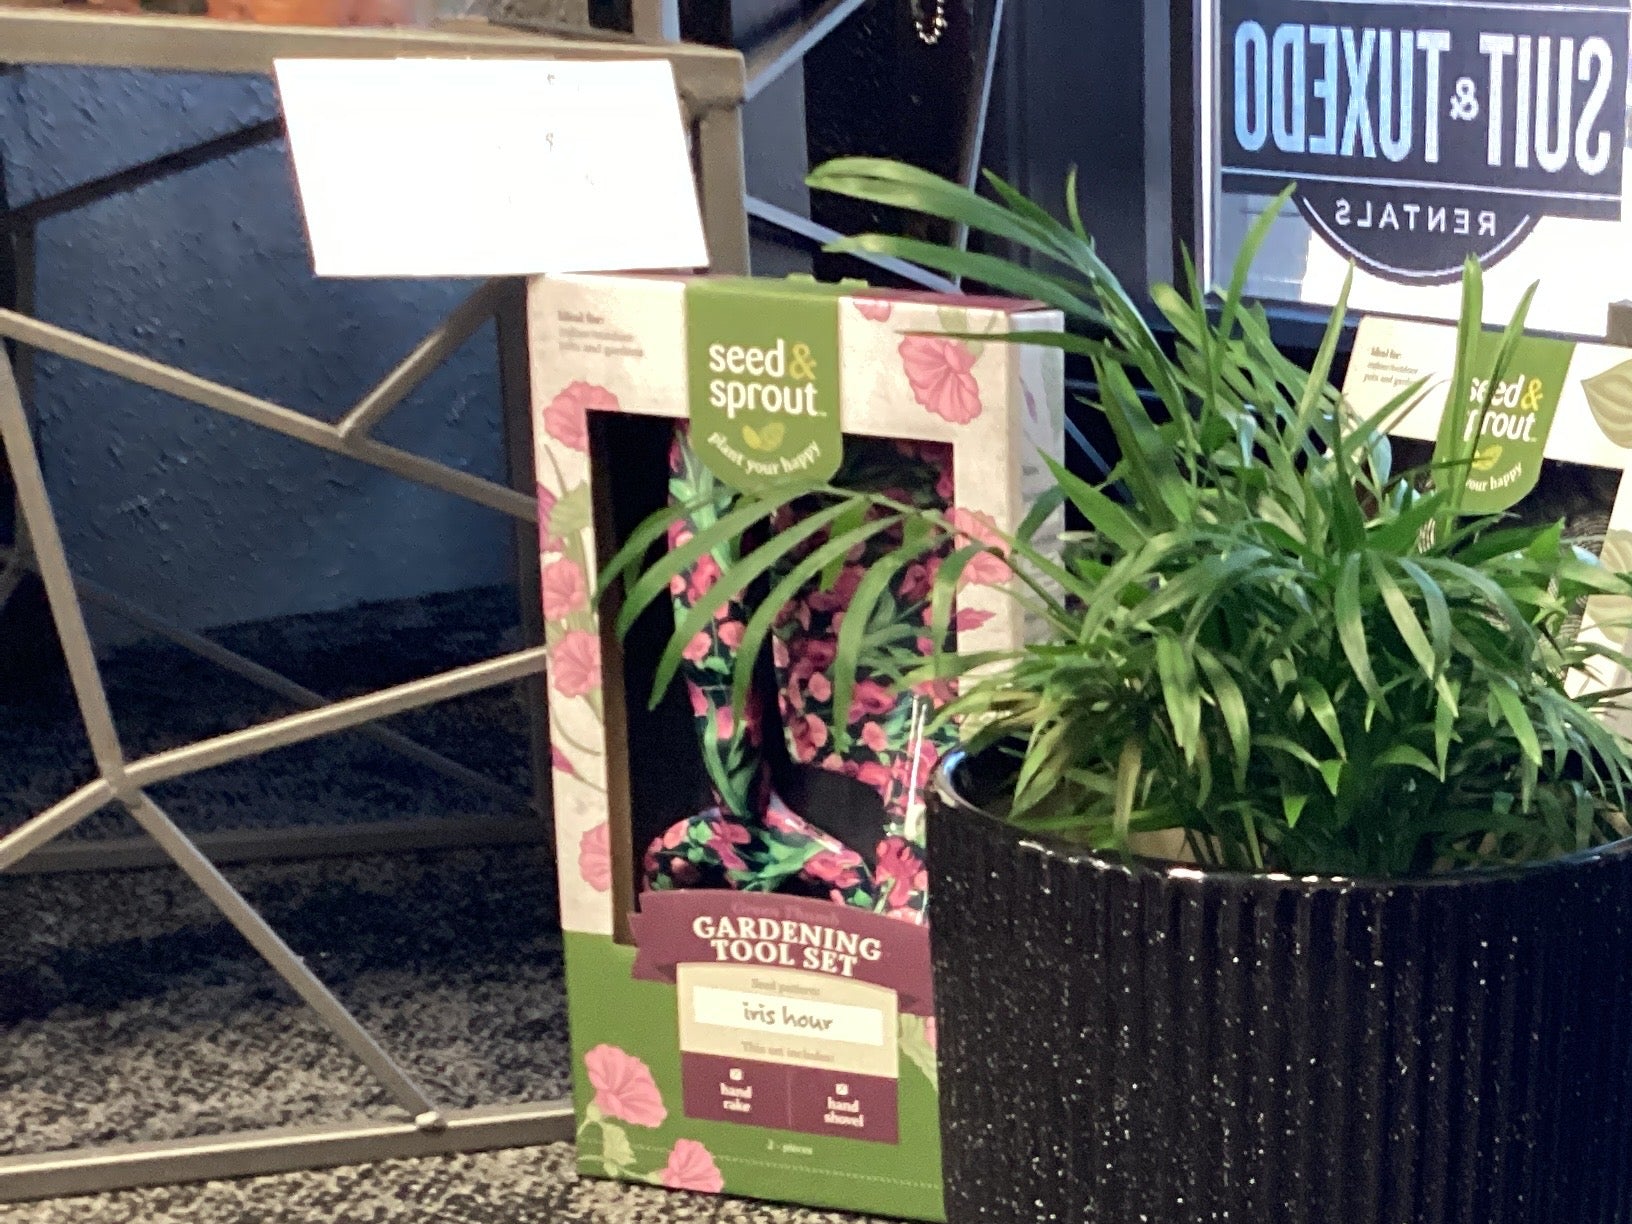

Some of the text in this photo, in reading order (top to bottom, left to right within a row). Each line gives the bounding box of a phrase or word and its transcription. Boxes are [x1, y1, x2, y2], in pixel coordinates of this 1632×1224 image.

[708, 338, 817, 380] seed &
[708, 379, 819, 419] sprout
[1520, 378, 1543, 411] &
[707, 431, 821, 475] plant your happy
[1489, 461, 1523, 491] happy
[692, 915, 882, 961] GARDENING
[711, 939, 858, 977] TOOL SET
[742, 1000, 834, 1031] iris hour
[719, 1081, 753, 1099] hand
[722, 1098, 752, 1113] rake
[827, 1096, 860, 1113] hand
[823, 1110, 865, 1128] shovel
